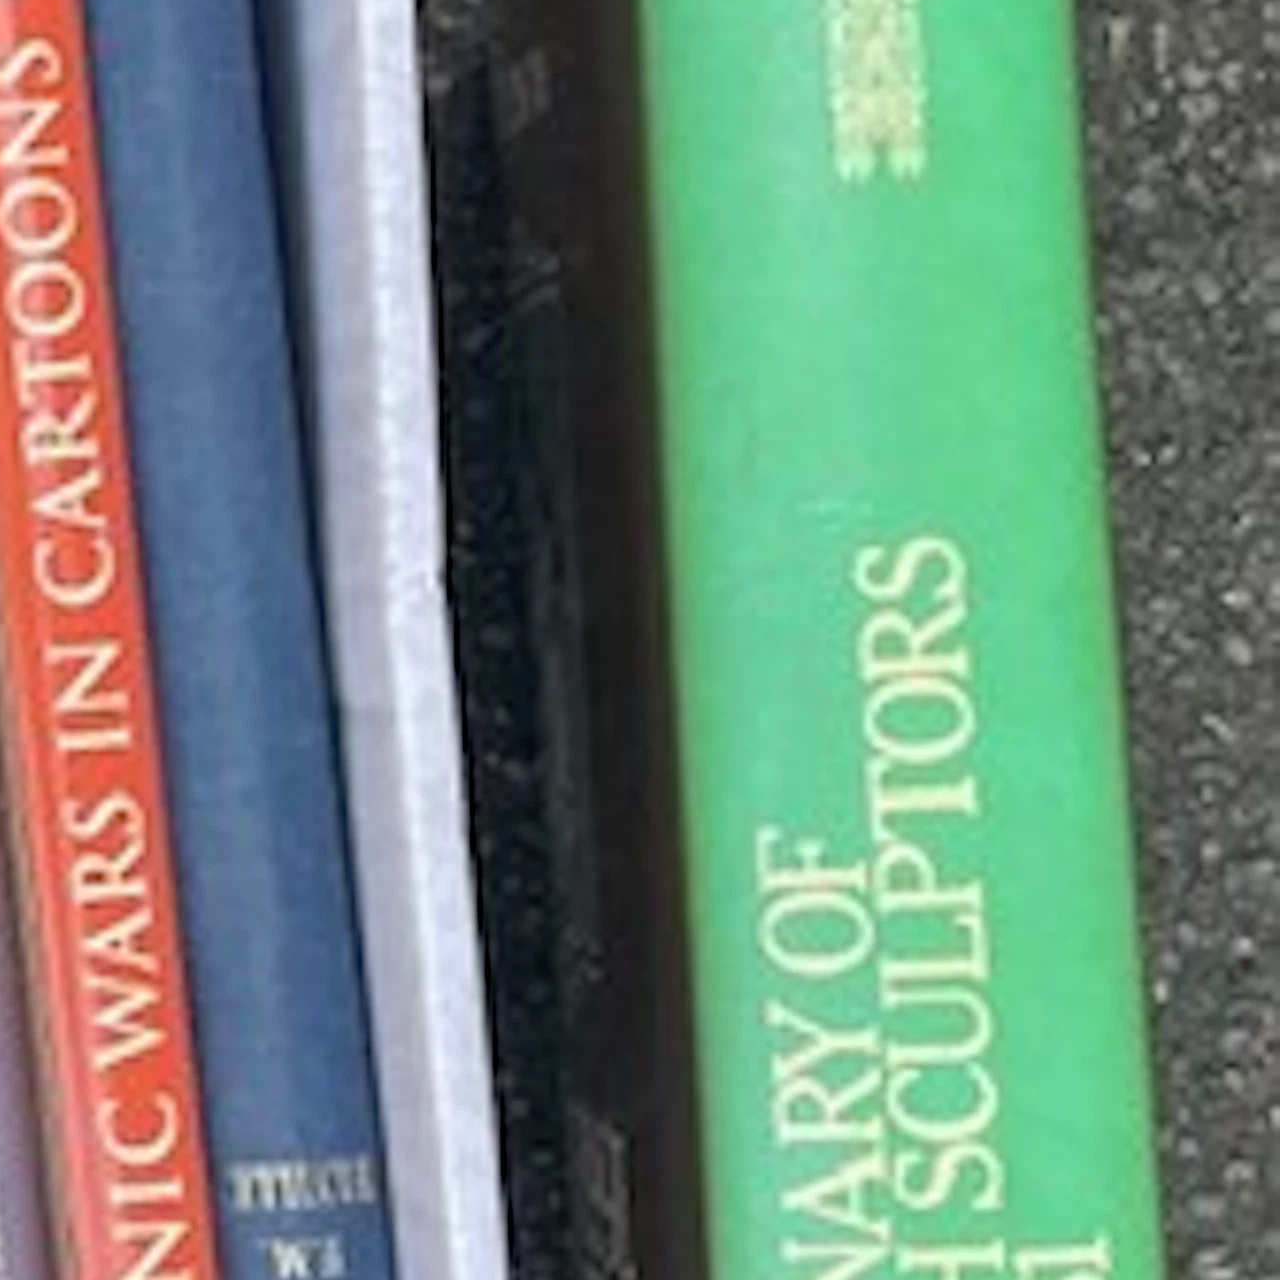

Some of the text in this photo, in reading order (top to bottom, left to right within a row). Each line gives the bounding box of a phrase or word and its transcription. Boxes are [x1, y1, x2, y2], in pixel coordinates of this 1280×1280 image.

[46, 642, 135, 753] IN
[58, 790, 168, 1074] WARS
[754, 826, 878, 978] OF
[852, 533, 1006, 1211] SCULPTORS
